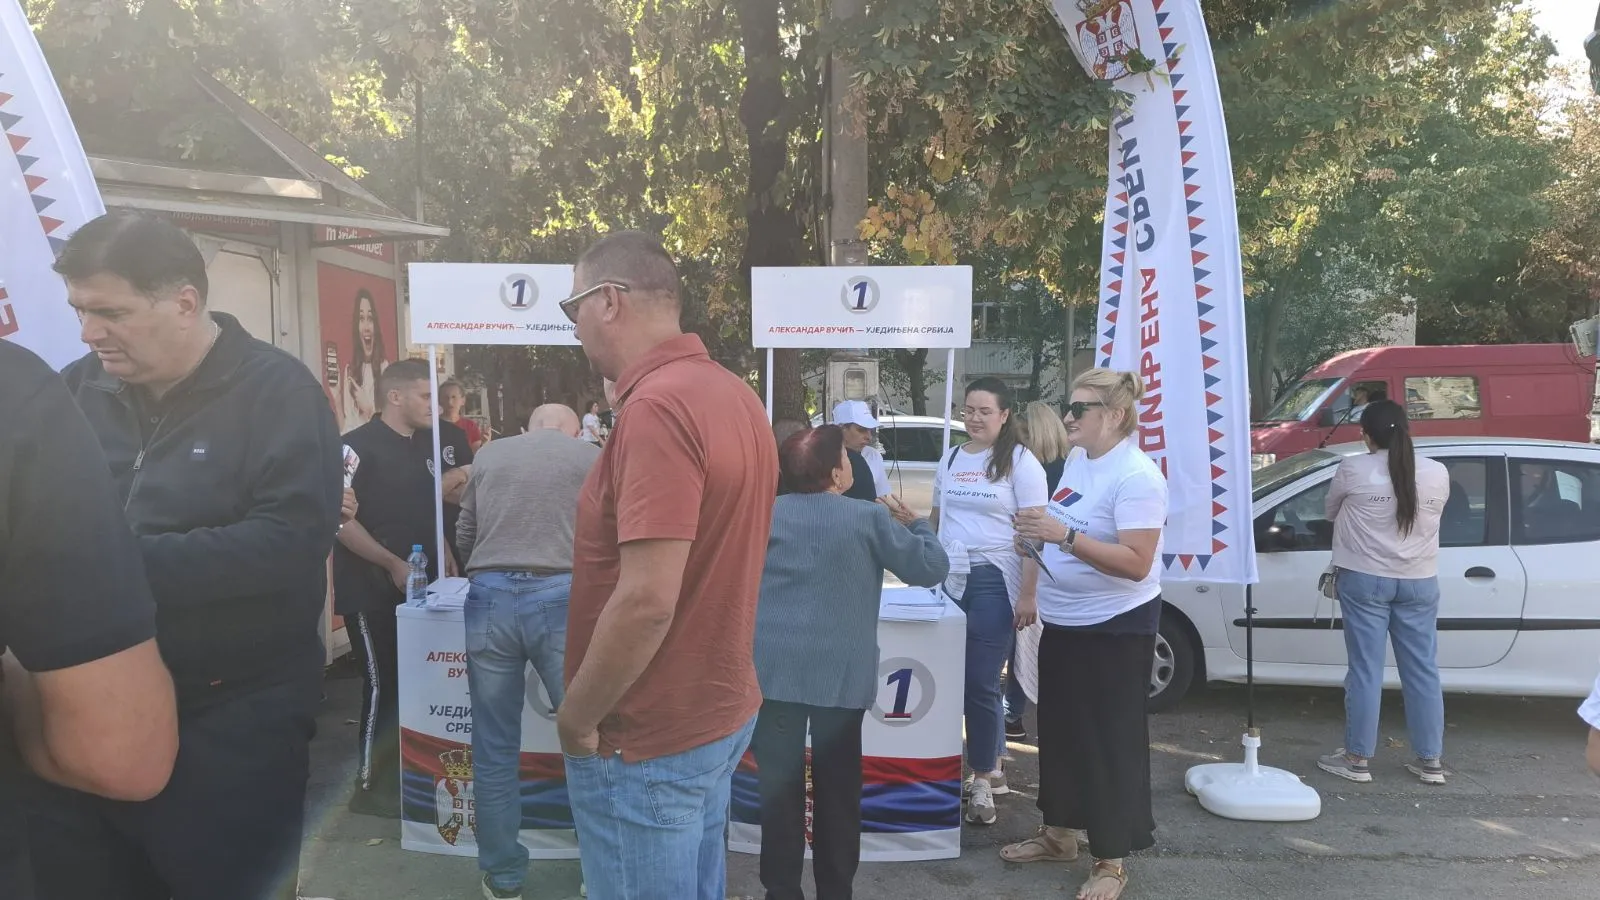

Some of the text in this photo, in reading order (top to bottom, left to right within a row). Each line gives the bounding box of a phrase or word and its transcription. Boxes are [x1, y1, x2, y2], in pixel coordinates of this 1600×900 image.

[511, 279, 527, 307] 1
[852, 281, 868, 311] 1
[427, 322, 484, 330] АЛЕКСАНДАР
[485, 323, 515, 331] ВУЧИЋ
[768, 326, 825, 334] АЛЕКСАНДАР
[826, 326, 855, 334] ВУЧИЋ
[865, 326, 919, 334] УЈЕДИЊЕНА
[920, 326, 954, 334] СРБИЈА
[427, 651, 468, 663] АЛЕКС
[884, 668, 913, 720] 1
[429, 704, 472, 719] УЈЕДИ
[446, 722, 472, 733] СРБ
